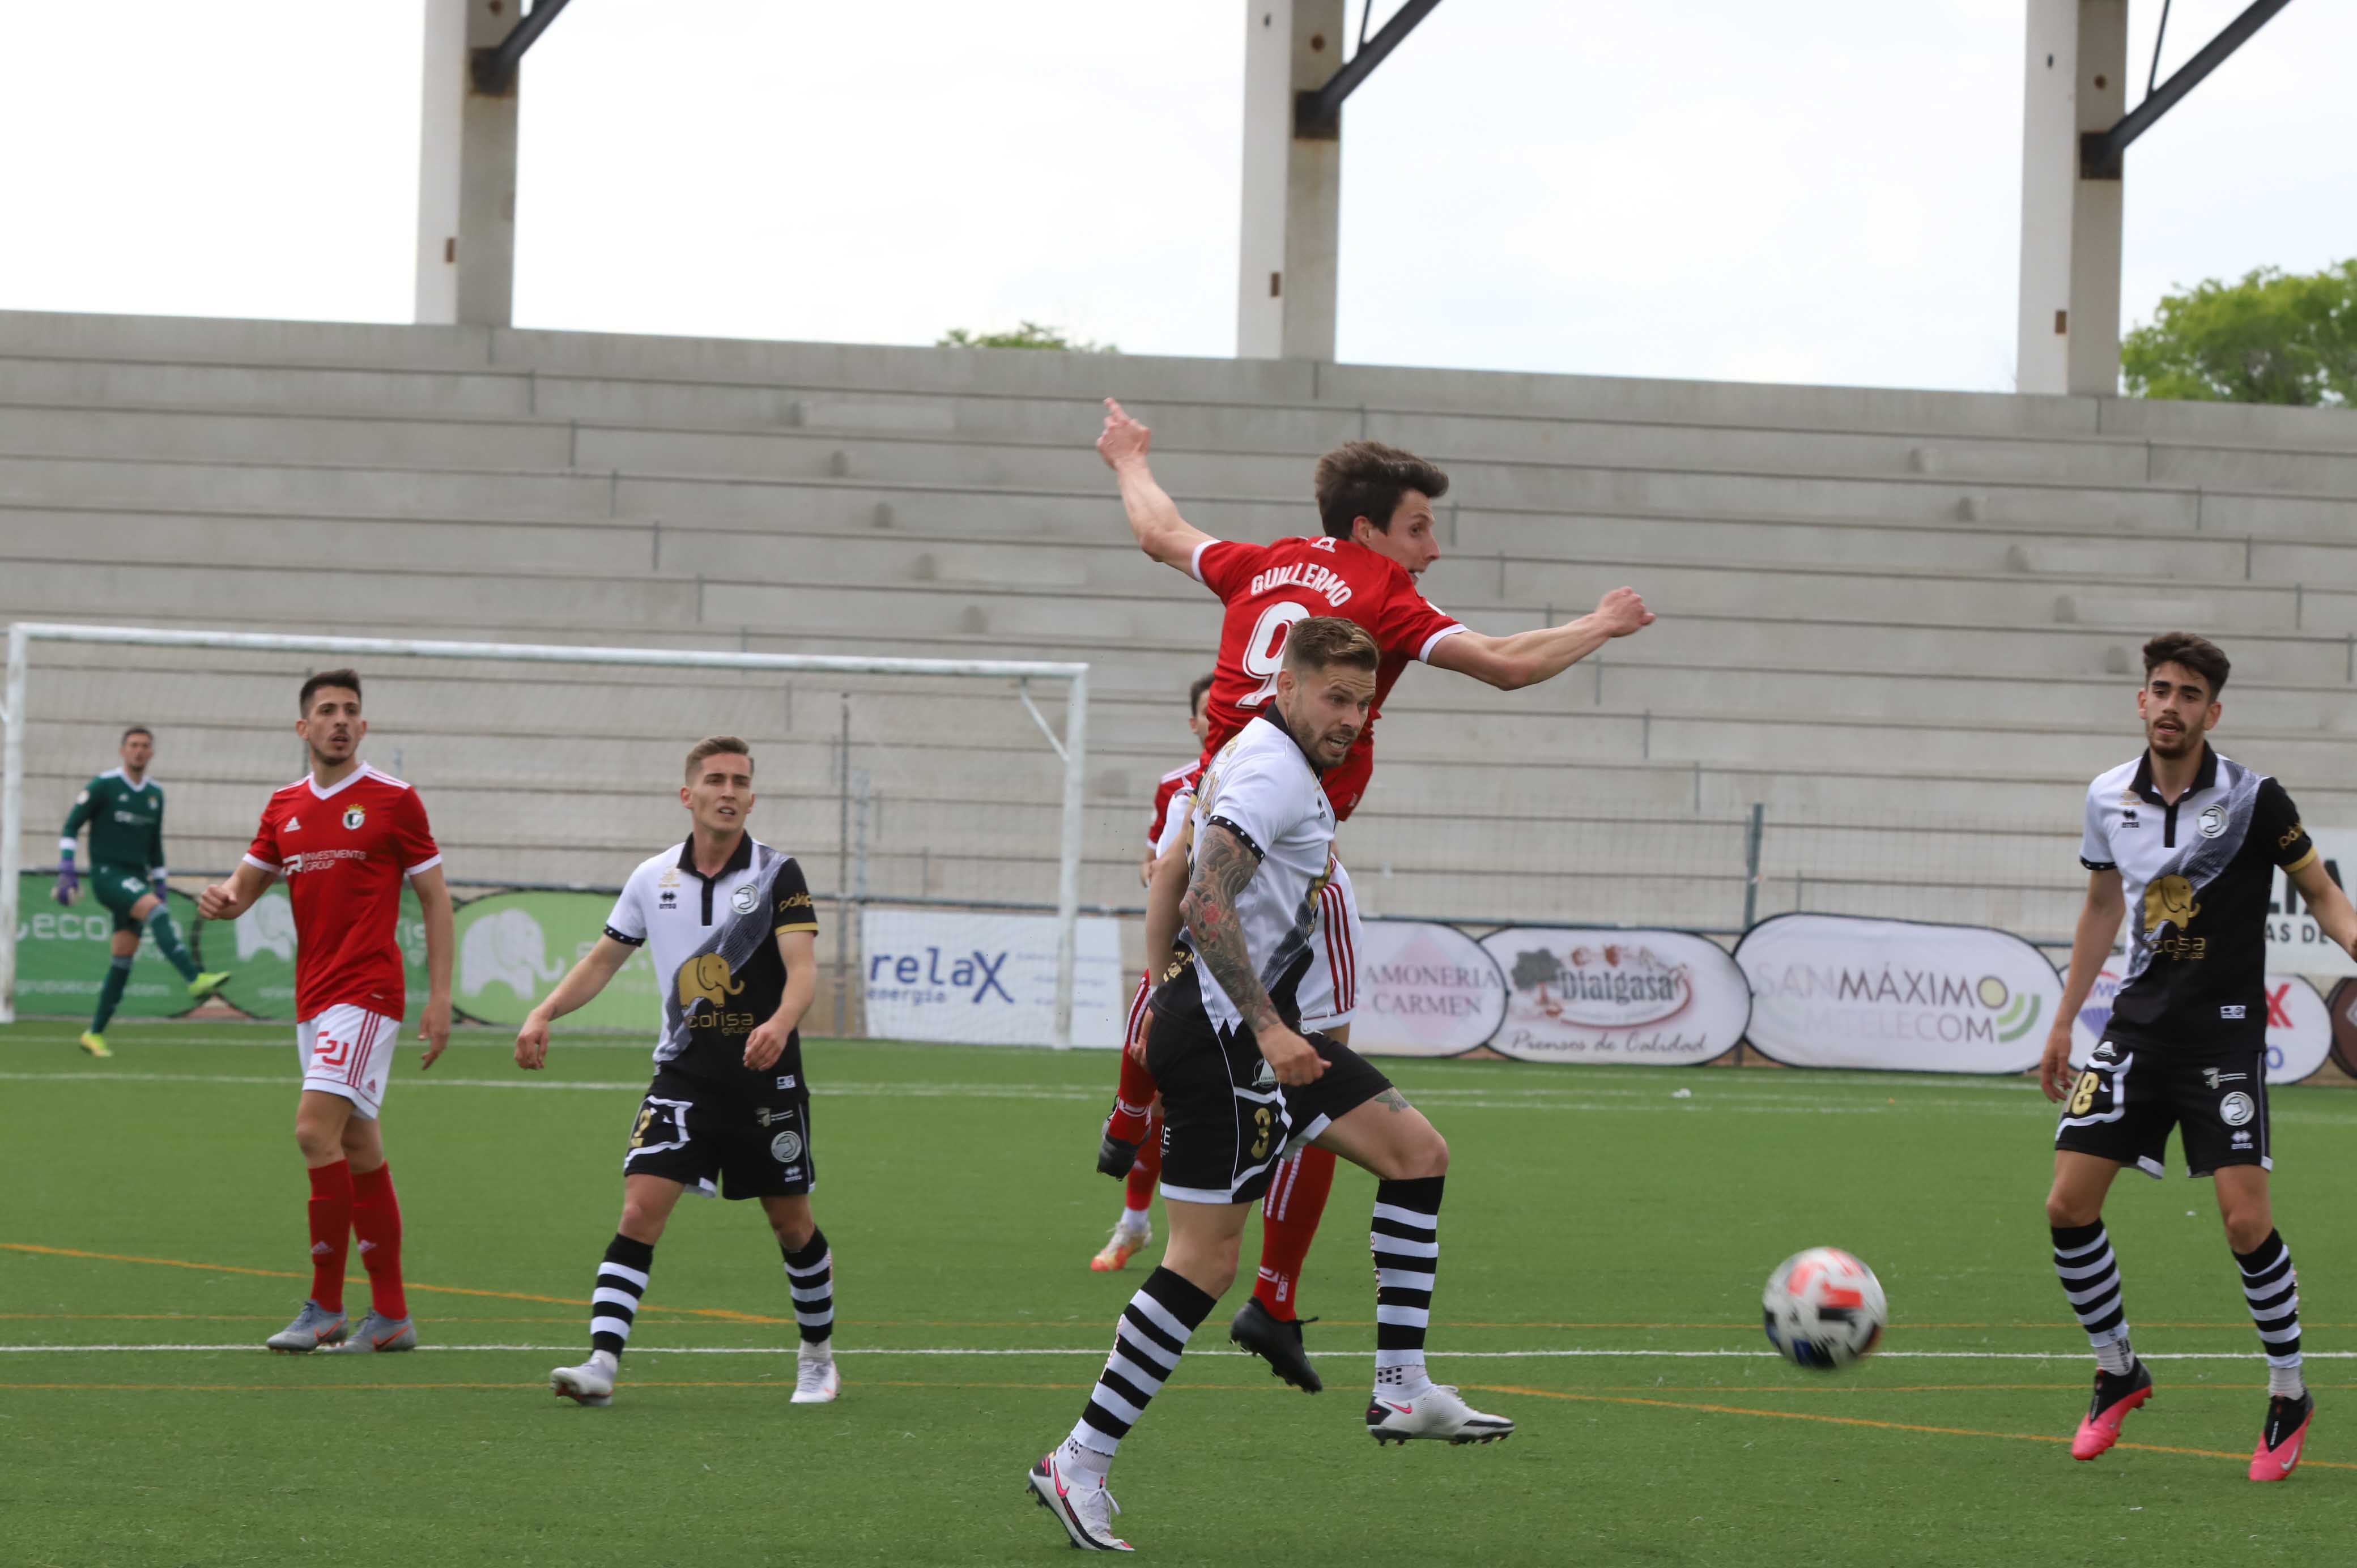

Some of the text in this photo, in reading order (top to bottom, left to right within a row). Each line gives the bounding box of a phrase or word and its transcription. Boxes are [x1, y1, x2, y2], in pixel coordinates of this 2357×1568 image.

[1250, 563, 1352, 608] GUILLERMO
[1236, 601, 1310, 709] 9
[305, 849, 367, 860] INVESTMENTS
[307, 859, 335, 872] GROUP
[1361, 965, 1501, 987] AMONERIA
[1560, 970, 1675, 1005] Dialgasa
[1372, 991, 1483, 1016] CARMEN
[684, 1011, 754, 1028] cotisa
[1512, 1029, 1707, 1052] Piensos de Calidad
[631, 1109, 652, 1148] 2
[1250, 1107, 1271, 1160] 3
